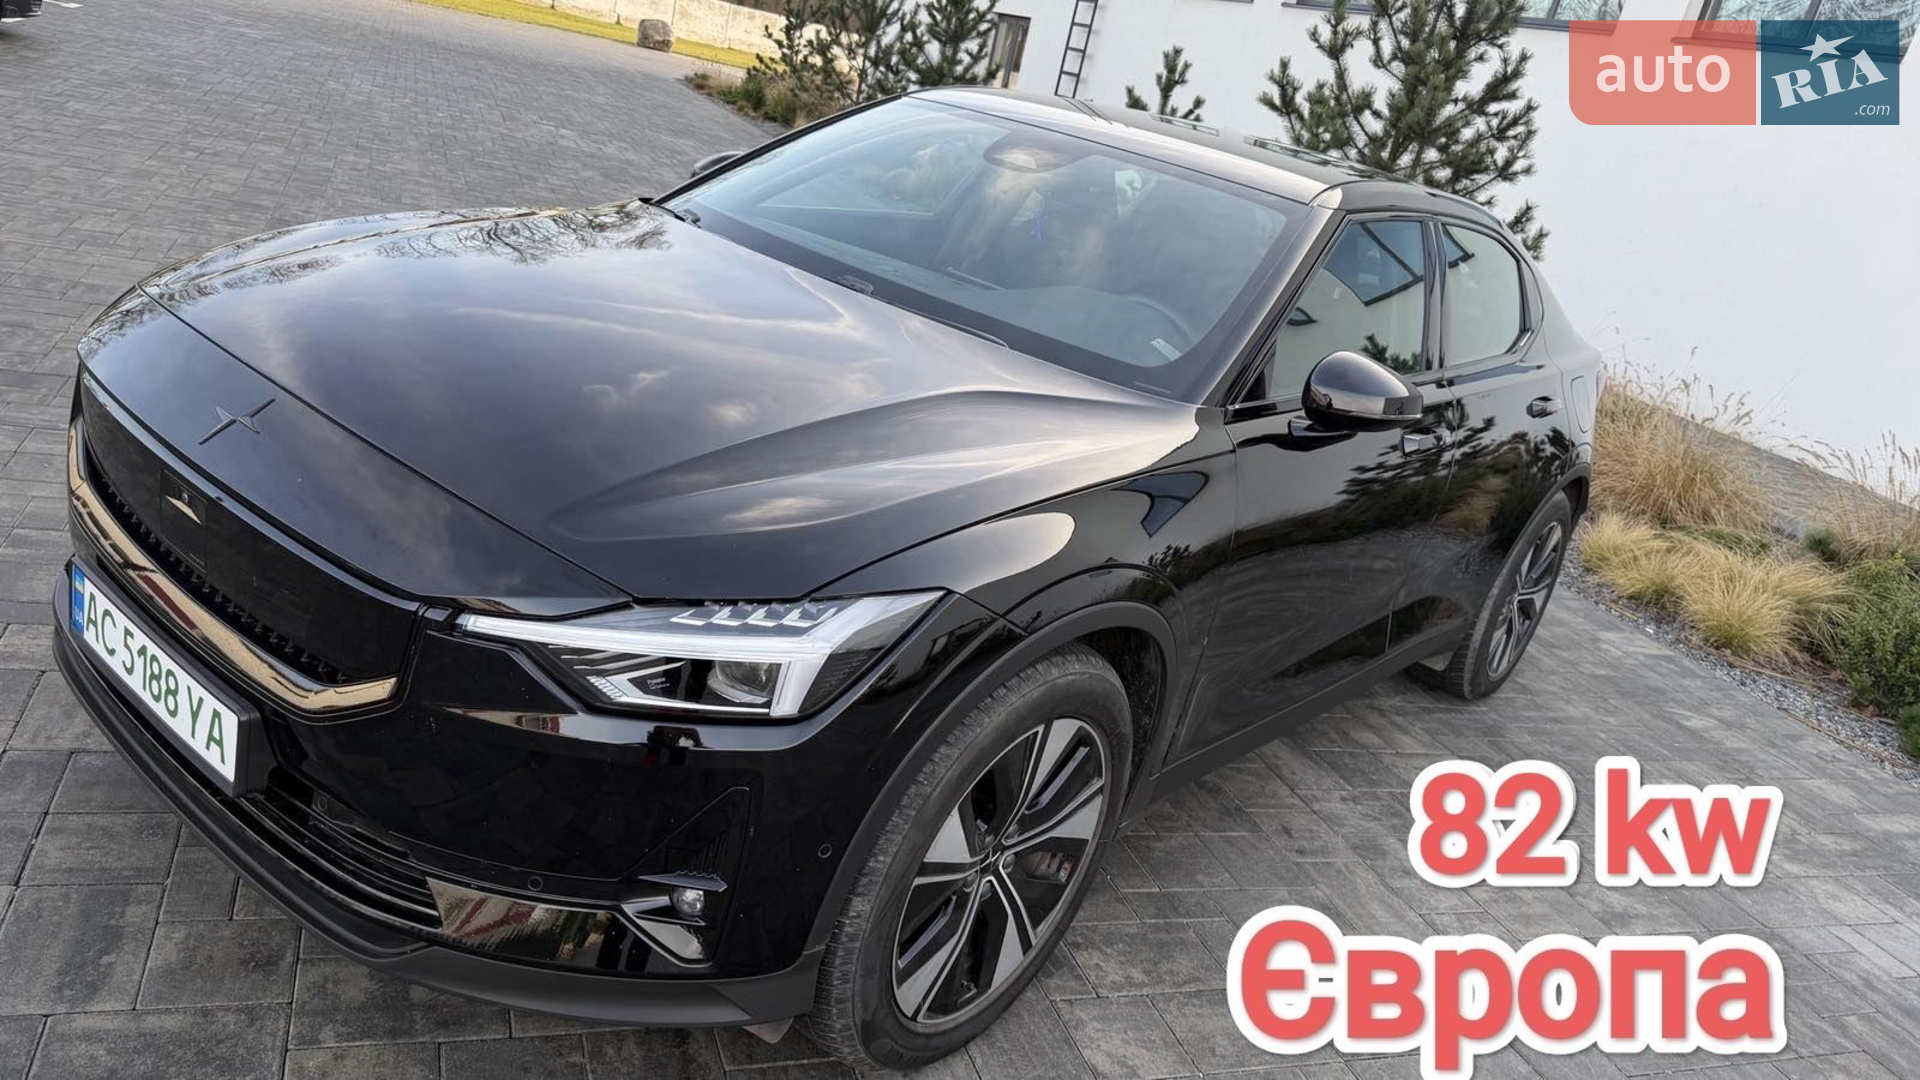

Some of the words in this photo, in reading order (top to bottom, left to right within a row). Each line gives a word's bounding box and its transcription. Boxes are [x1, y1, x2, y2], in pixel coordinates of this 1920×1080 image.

[85, 591, 117, 658] AC
[121, 625, 180, 720] 5188
[186, 684, 226, 766] YA
